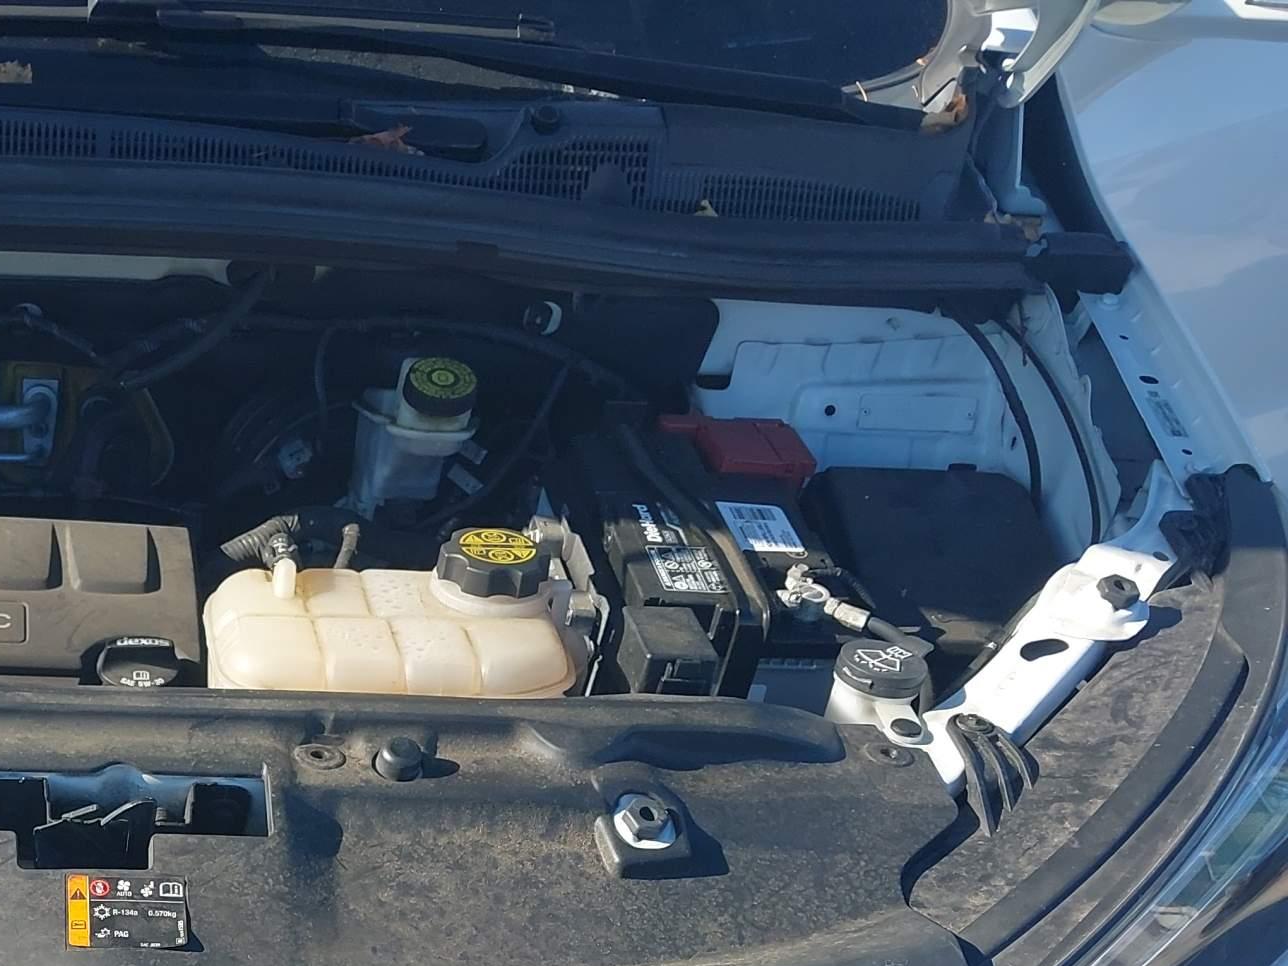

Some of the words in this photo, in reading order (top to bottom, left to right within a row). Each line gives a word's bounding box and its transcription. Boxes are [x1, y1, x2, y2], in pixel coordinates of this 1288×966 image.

[632, 504, 663, 542] DieHard
[116, 637, 170, 646] dexos
[148, 910, 177, 918] 0.570kg
[113, 930, 129, 938] PAG
